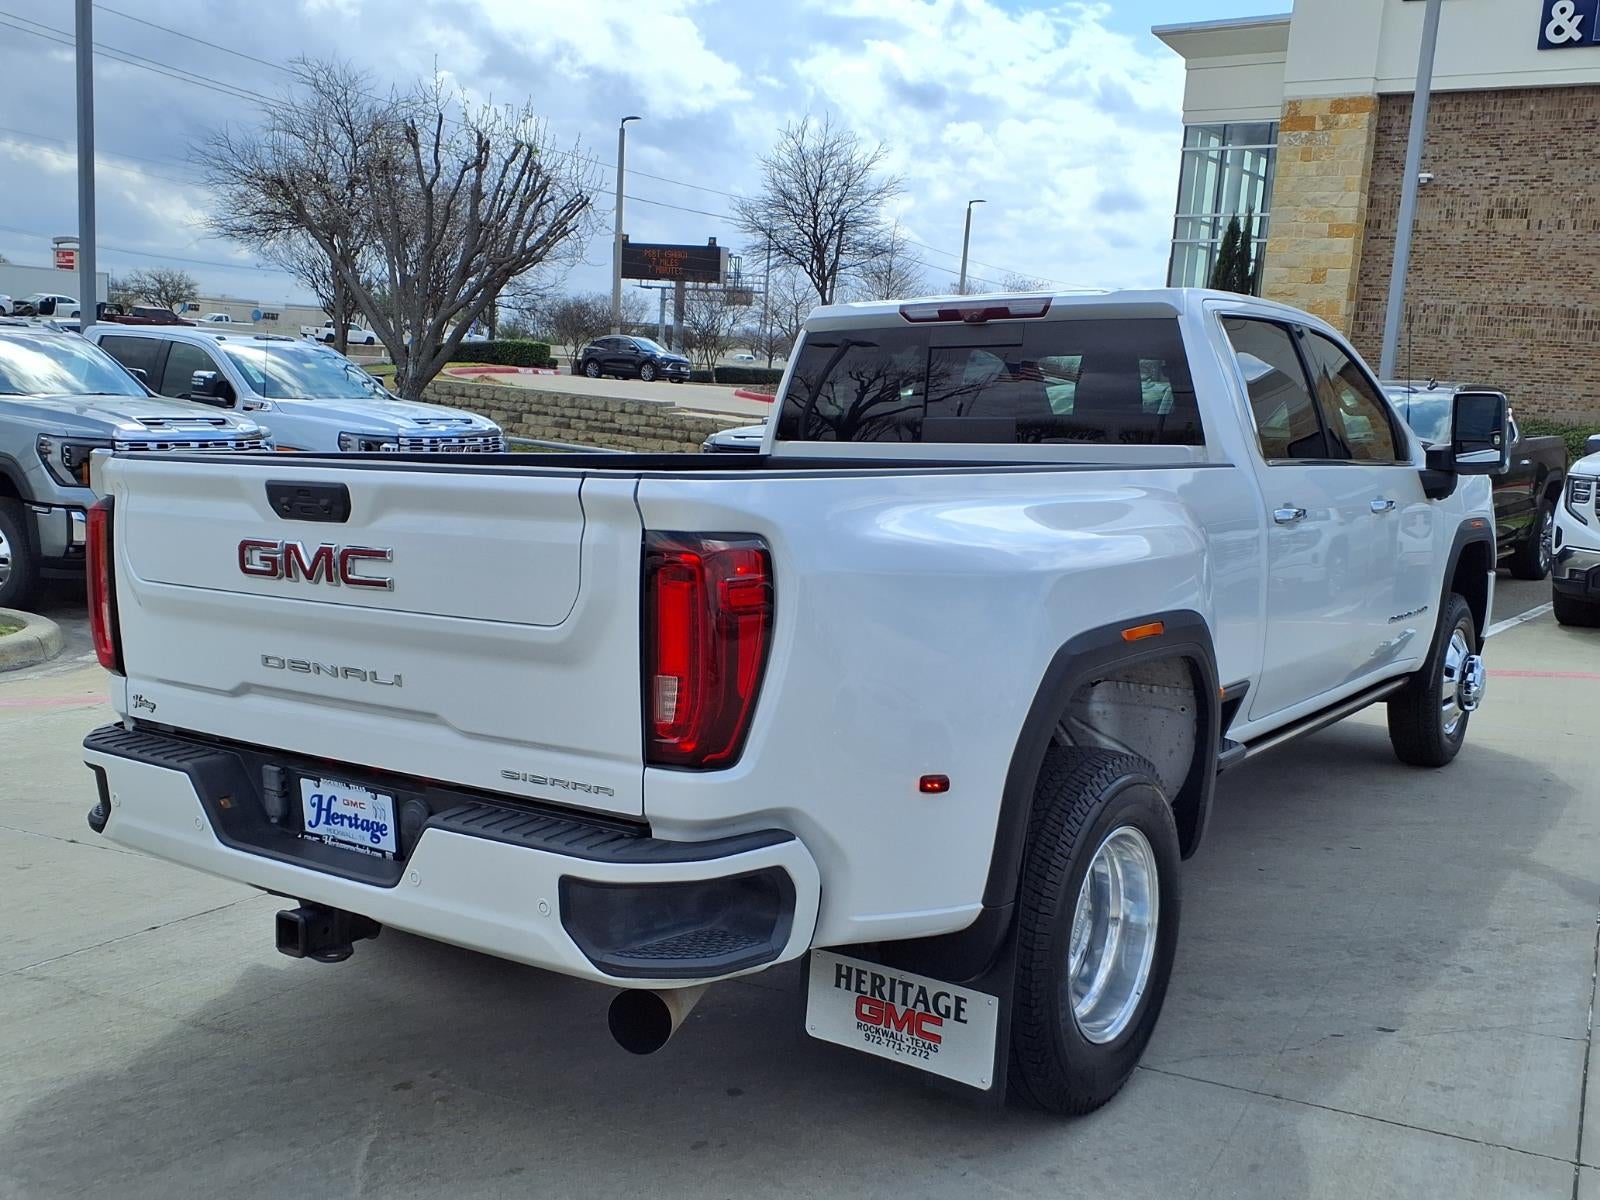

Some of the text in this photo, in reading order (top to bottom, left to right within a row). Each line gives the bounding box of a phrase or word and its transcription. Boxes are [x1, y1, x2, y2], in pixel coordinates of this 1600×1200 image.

[1545, 0, 1584, 44] &
[659, 258, 679, 267] MILES
[262, 312, 280, 321] AT&T
[238, 537, 394, 592] GMC
[260, 654, 403, 688] DENALI
[500, 769, 614, 797] SIERRA
[308, 794, 388, 844] Heritage
[343, 799, 366, 809] GMC
[834, 963, 968, 1024] HERITAGE
[855, 995, 943, 1044] GMC
[864, 1032, 931, 1060] 972-771-7272
